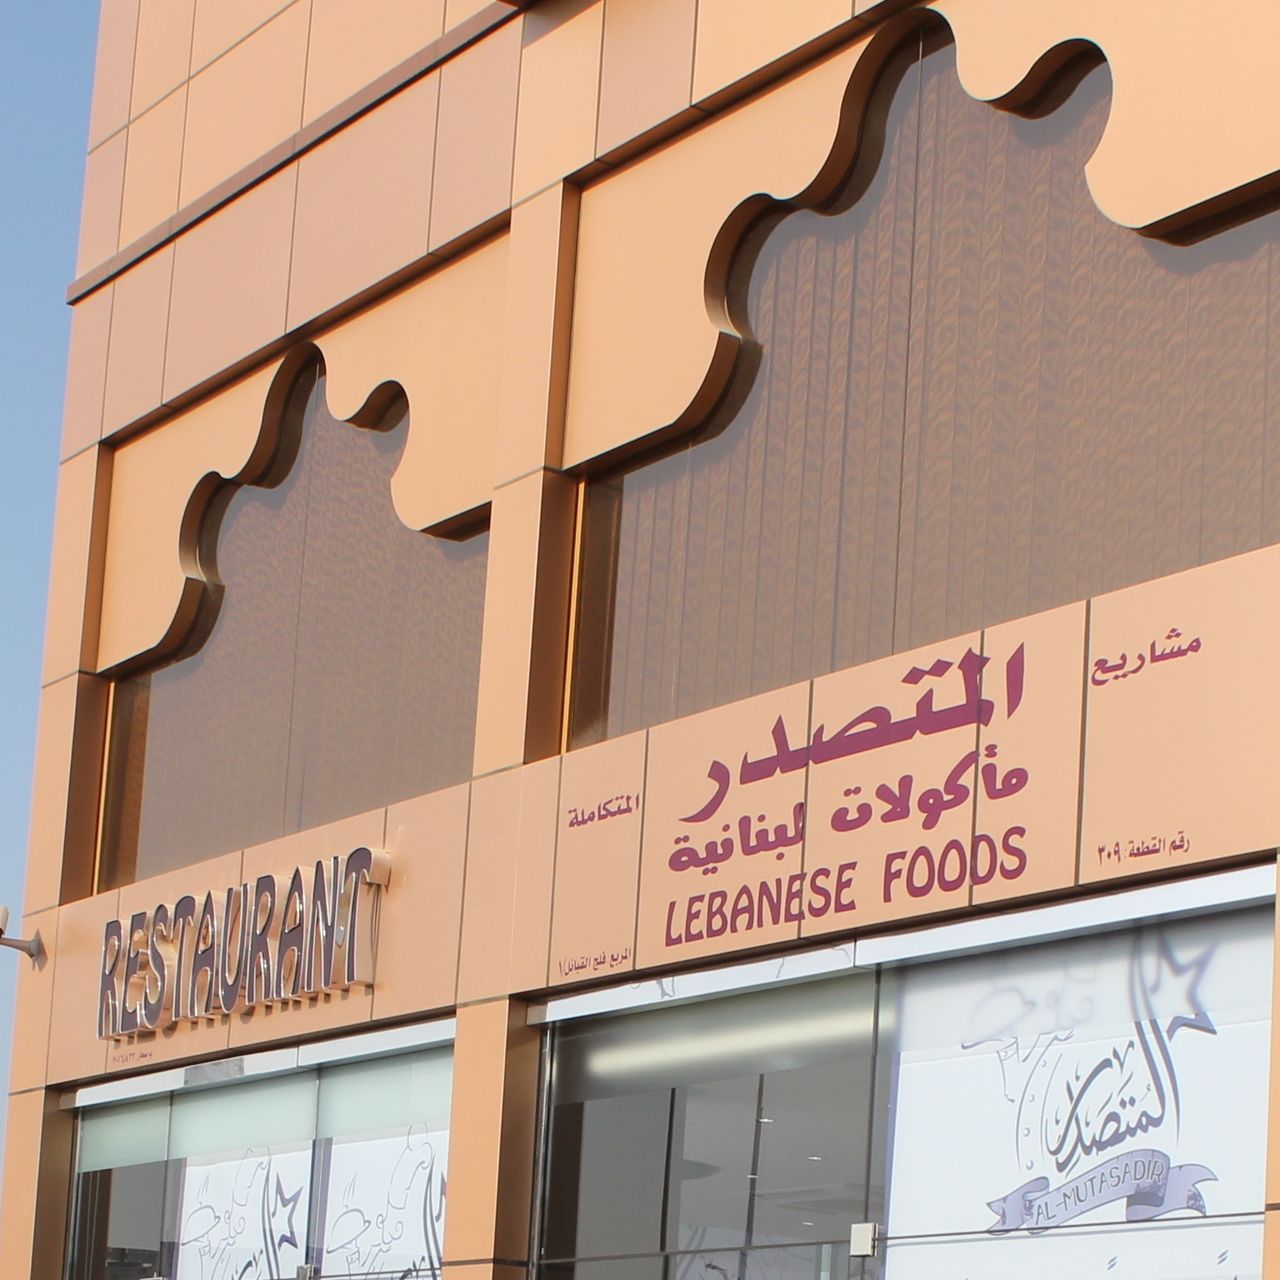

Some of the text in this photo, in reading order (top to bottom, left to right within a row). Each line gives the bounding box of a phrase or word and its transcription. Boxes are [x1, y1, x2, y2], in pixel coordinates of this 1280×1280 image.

[1091, 628, 1202, 686] مشاريع
[678, 641, 1025, 823] المتصدر
[568, 793, 640, 828] المتكاملة
[668, 743, 1029, 876] مأكولات لبنانية
[1098, 841, 1122, 867] ٣٠٩
[1169, 830, 1191, 857] رقم
[665, 826, 1028, 947] LEBANESE FOODS
[96, 847, 382, 1040] RESTAURANT
[1035, 1159, 1165, 1226] AL-MUTASADIR
